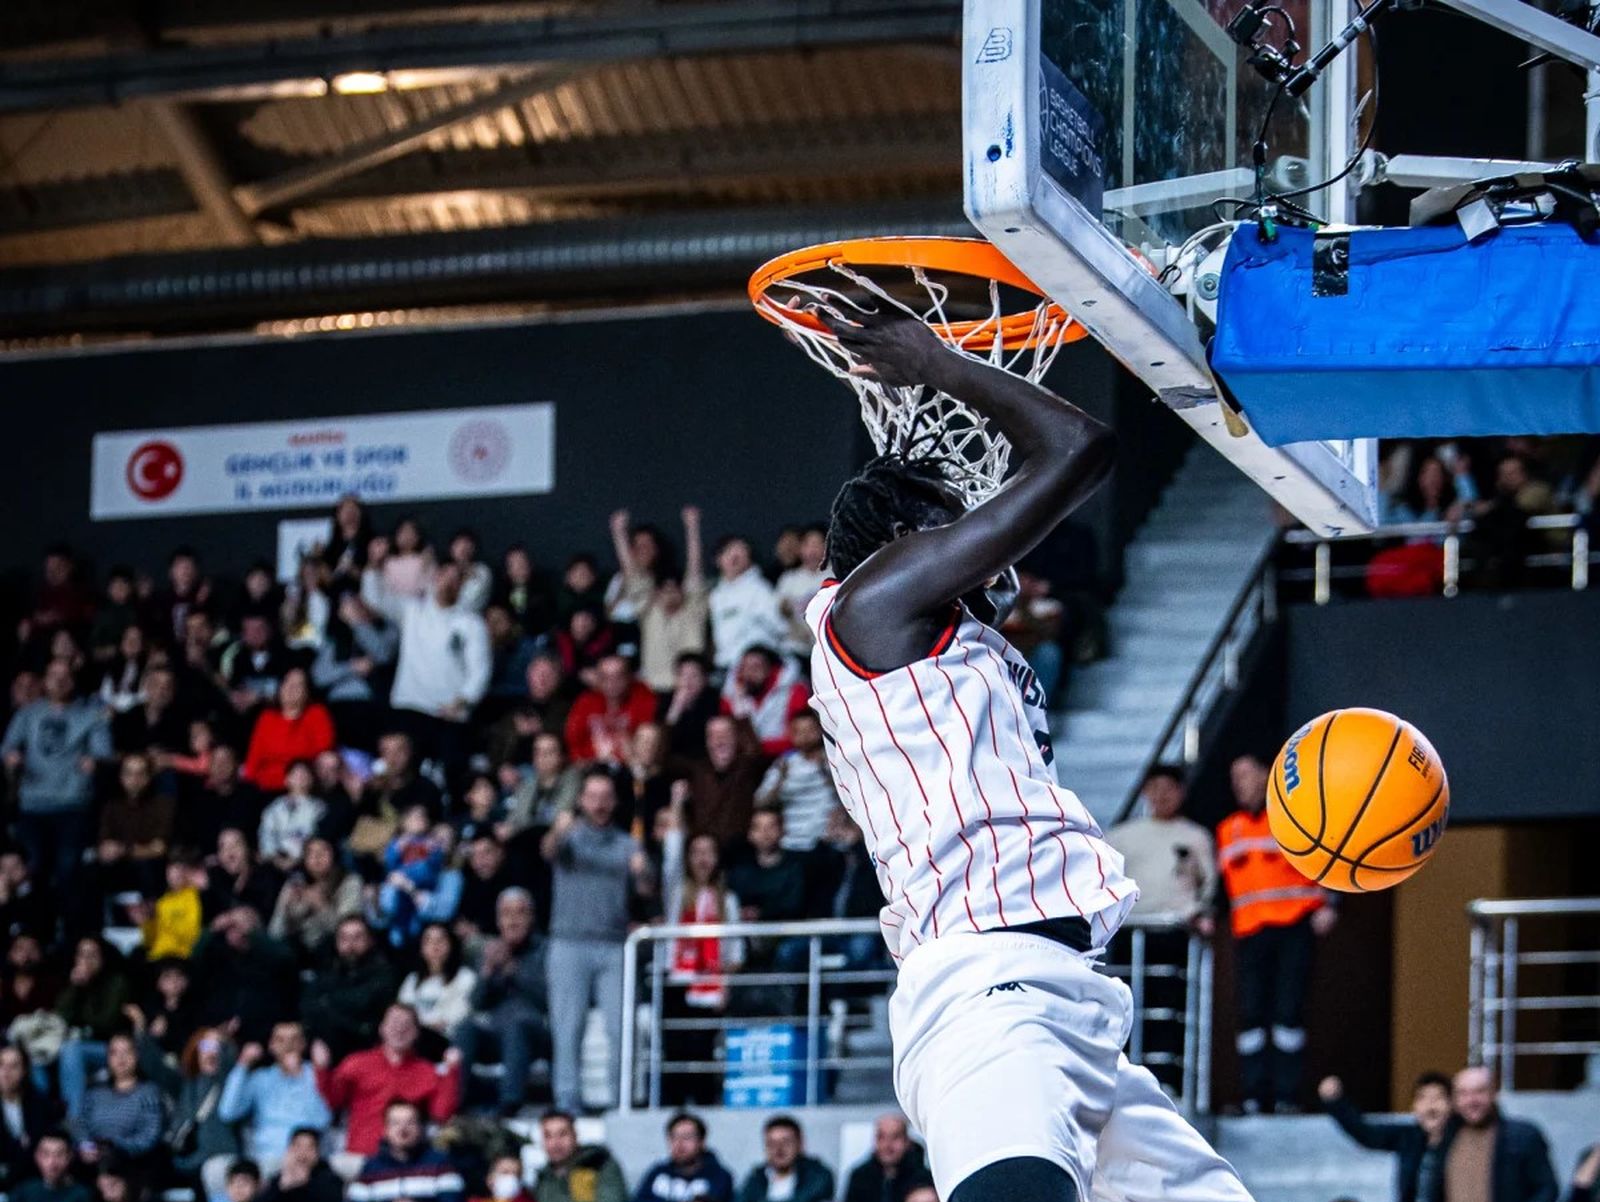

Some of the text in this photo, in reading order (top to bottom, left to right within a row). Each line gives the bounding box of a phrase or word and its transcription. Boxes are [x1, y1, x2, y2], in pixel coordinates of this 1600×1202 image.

[1049, 110, 1101, 178] CHAMPIONS
[1050, 87, 1096, 149] BASKETBALL
[1049, 132, 1078, 177] LEAGUE
